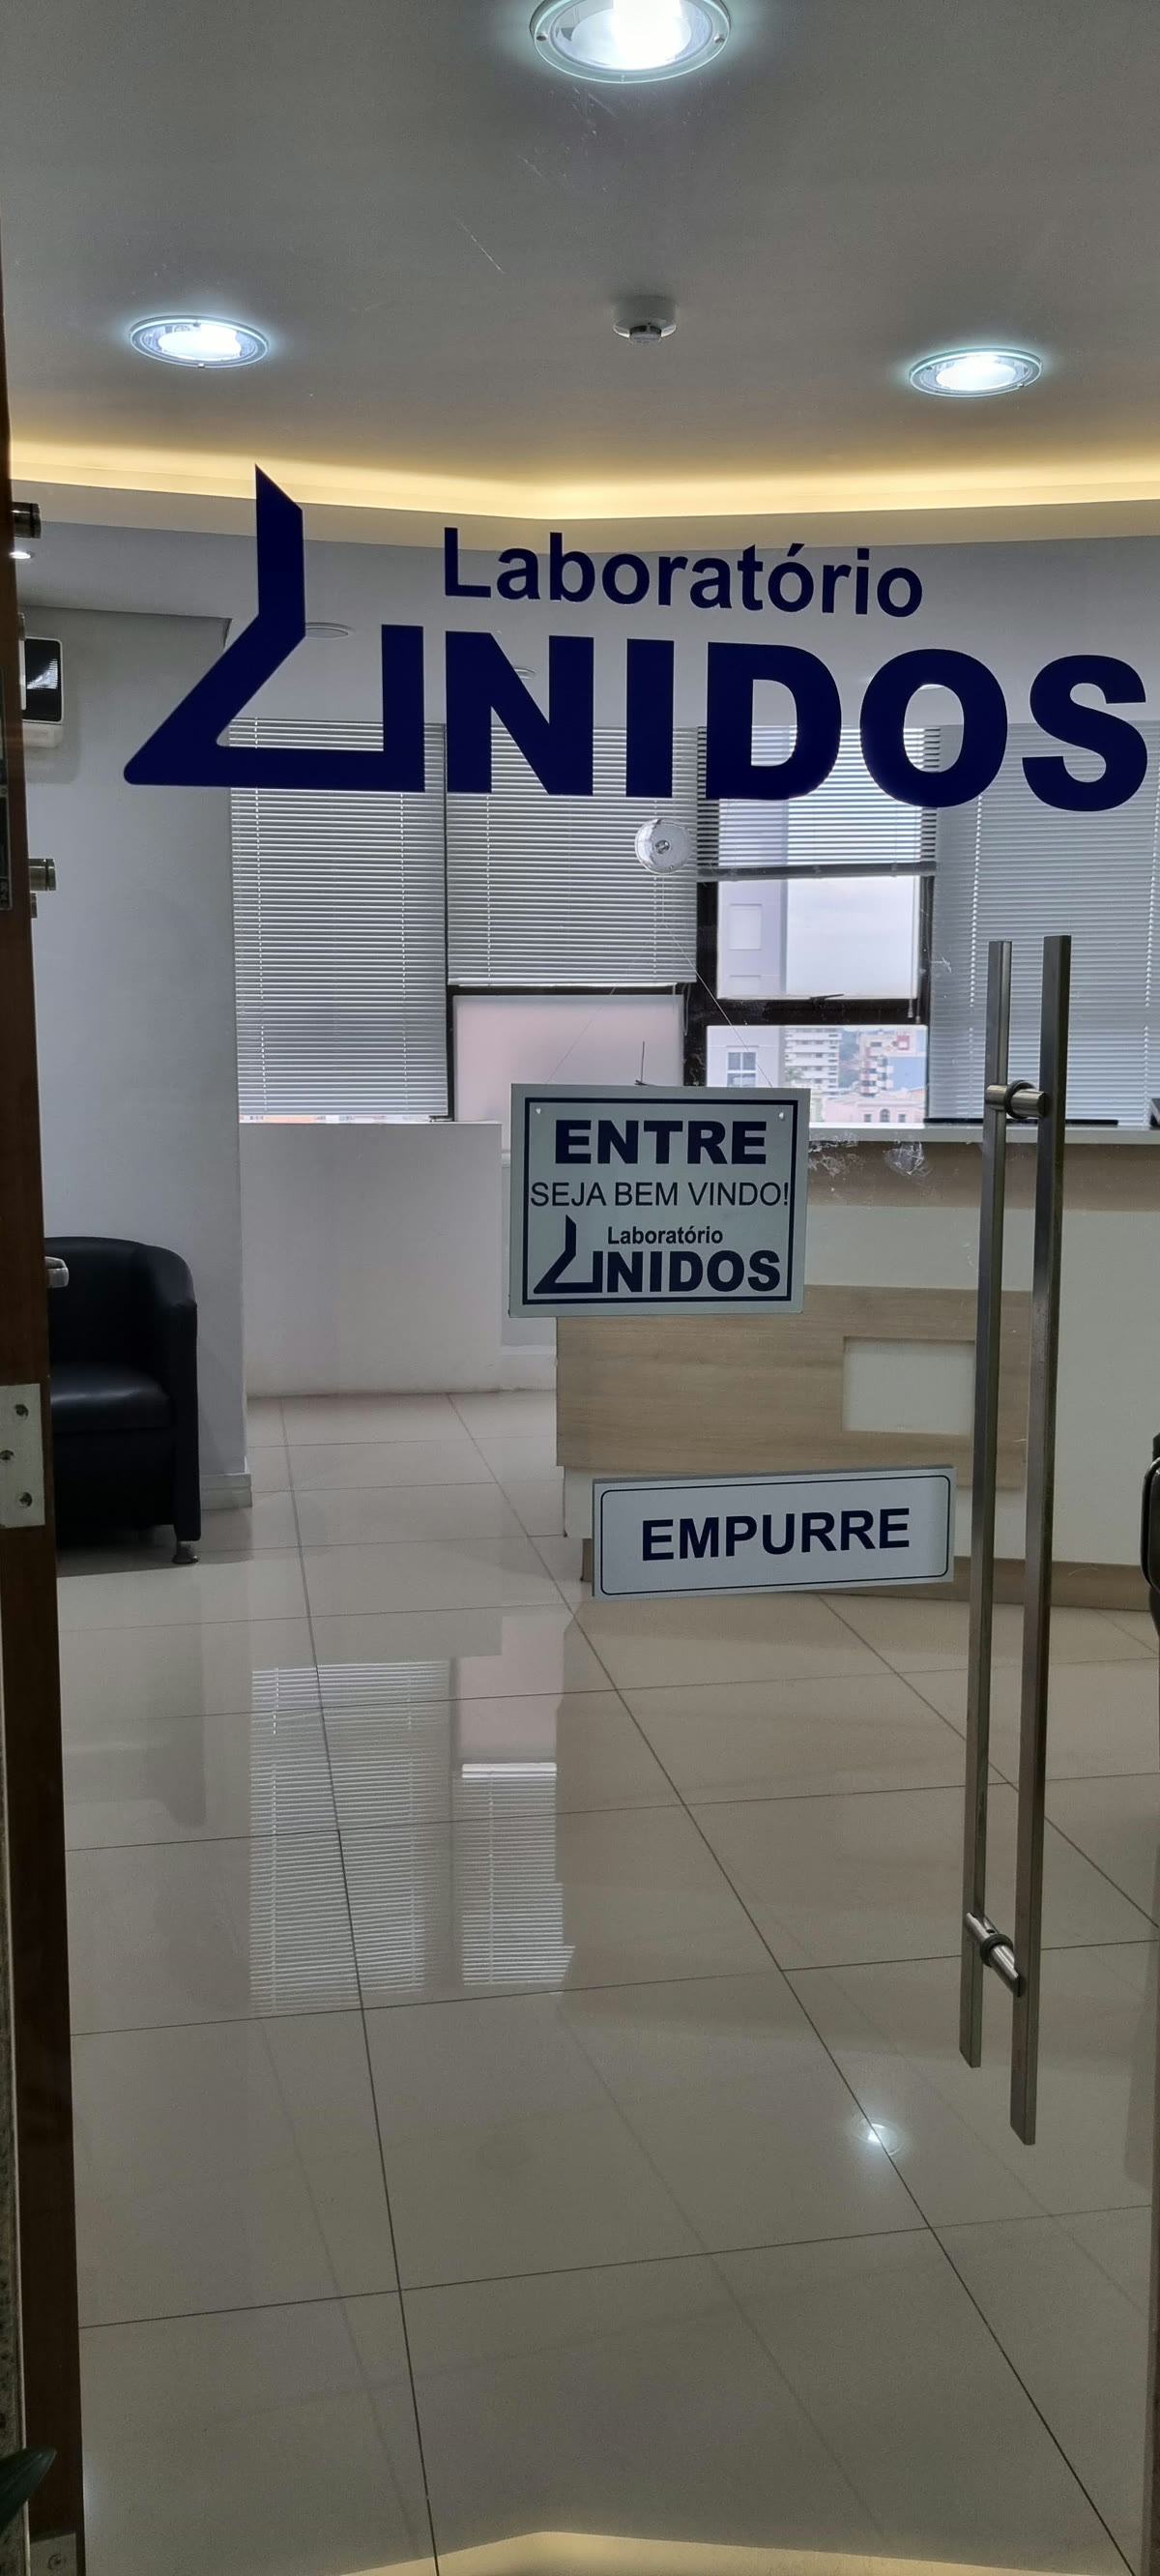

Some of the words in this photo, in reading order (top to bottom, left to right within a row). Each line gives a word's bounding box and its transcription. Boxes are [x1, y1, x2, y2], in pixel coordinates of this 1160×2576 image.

[443, 527, 924, 619] Laboratório
[555, 1119, 768, 1165] ENTRE
[531, 1182, 607, 1207] SEJA
[614, 1182, 679, 1207] BEM
[687, 1182, 789, 1207] VINDO!
[607, 1225, 723, 1245] Laboratório
[642, 1508, 911, 1562] EMPURRE
